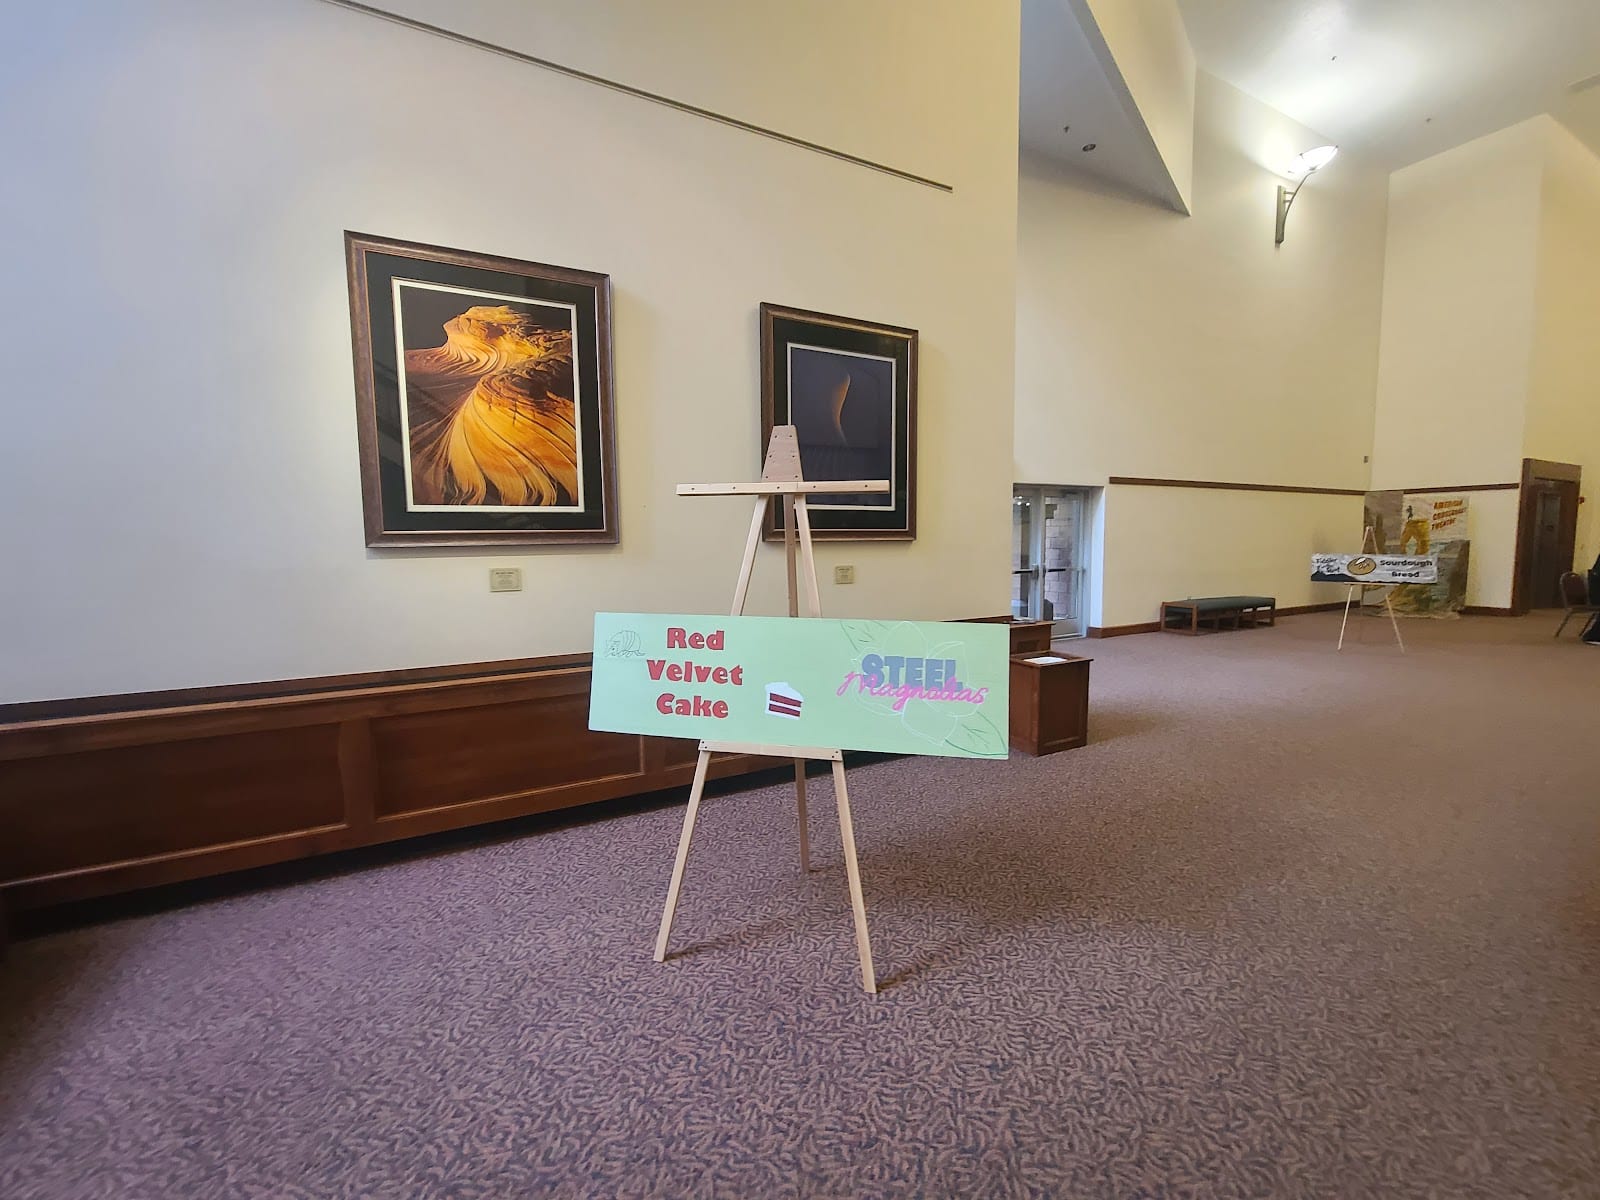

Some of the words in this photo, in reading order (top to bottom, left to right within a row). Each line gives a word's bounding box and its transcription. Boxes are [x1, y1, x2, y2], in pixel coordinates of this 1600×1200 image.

[1379, 559, 1433, 567] Sourdough
[666, 627, 725, 651] Red
[646, 659, 744, 686] Velvet
[861, 653, 964, 691] STEEL
[836, 671, 989, 712] Magnolias
[656, 692, 729, 719] Cake
